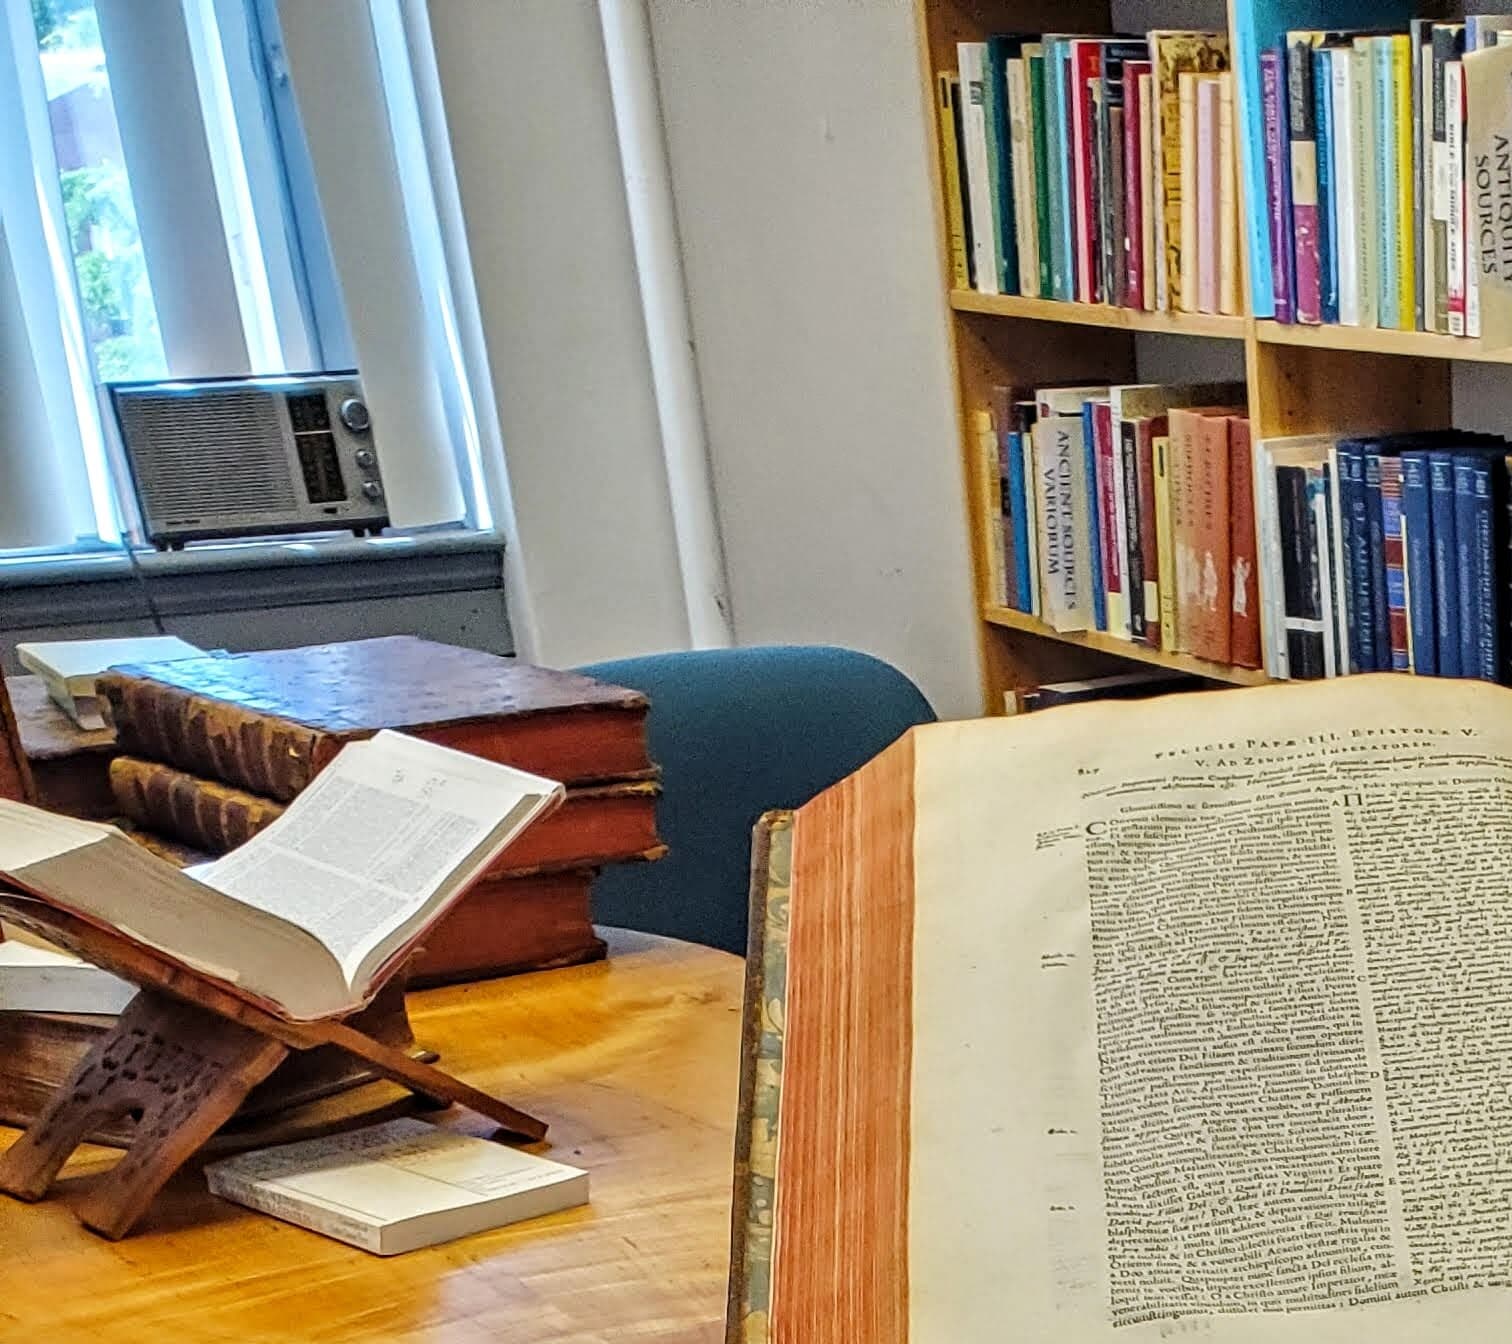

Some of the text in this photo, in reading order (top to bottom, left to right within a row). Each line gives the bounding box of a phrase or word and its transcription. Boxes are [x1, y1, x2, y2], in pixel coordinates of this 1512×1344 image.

[1476, 156, 1497, 274] SOURCES
[1044, 469, 1059, 574] VARIORUM
[1057, 431, 1077, 610] ANCIENT SOURCES
[1349, 1294, 1392, 1307] Domini
